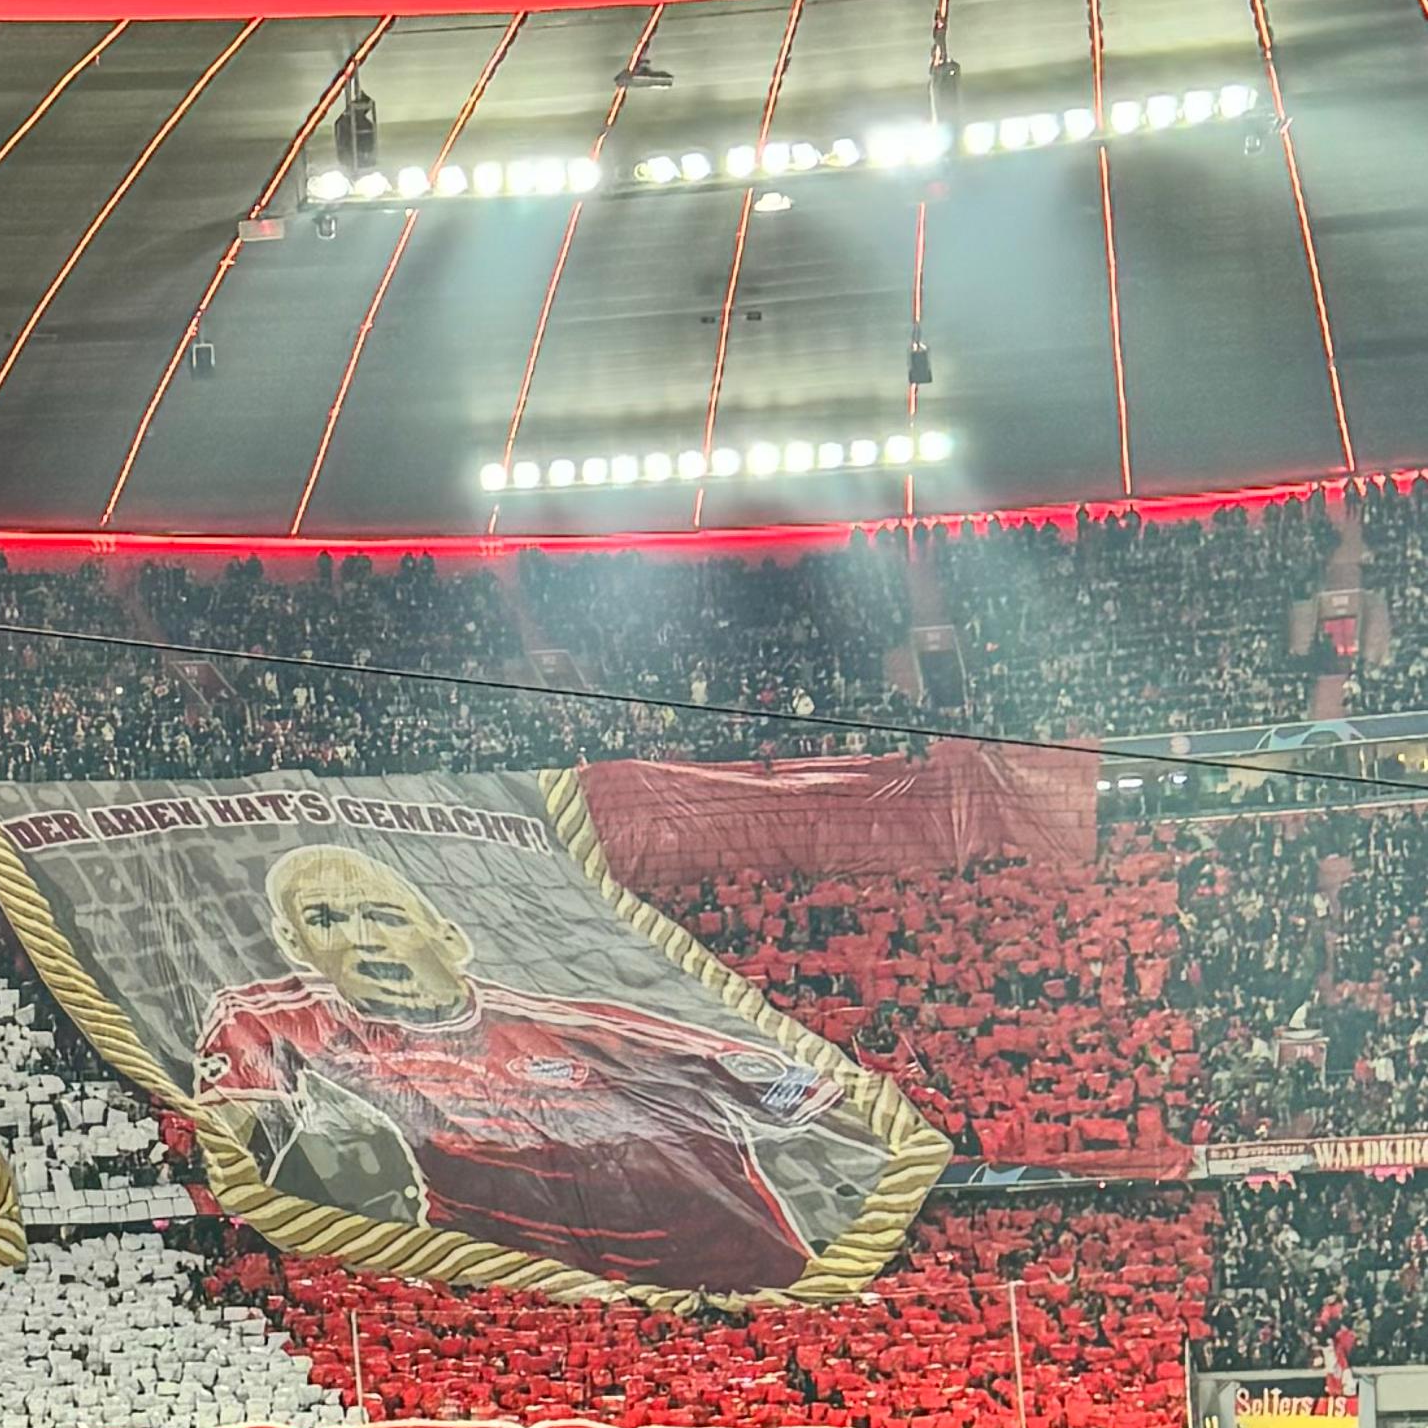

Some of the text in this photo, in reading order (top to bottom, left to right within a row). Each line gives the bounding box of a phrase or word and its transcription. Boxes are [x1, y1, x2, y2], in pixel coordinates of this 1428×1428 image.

[4, 811, 87, 850] DER
[206, 791, 331, 825] HAT'S
[339, 797, 548, 853] GEMACHT!
